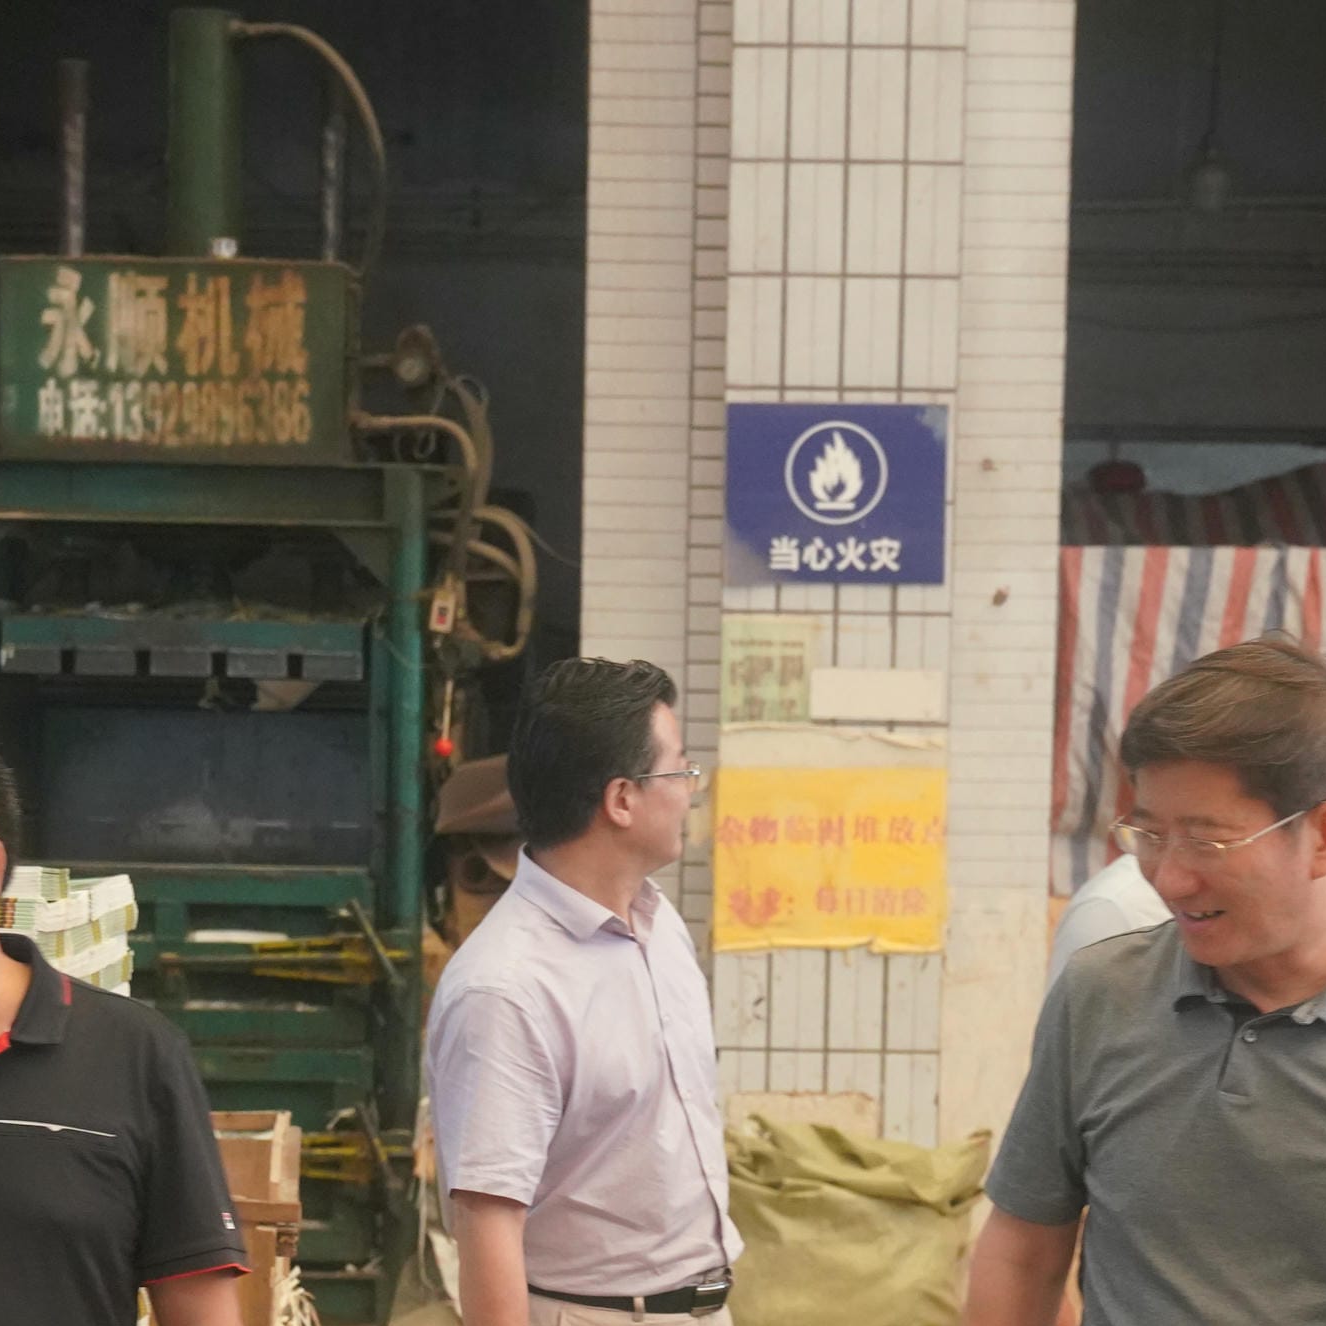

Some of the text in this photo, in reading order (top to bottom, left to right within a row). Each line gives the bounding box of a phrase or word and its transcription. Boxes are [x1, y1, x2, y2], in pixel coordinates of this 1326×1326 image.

[38, 265, 309, 377] 永顺机械
[769, 535, 902, 572] 当心火灾
